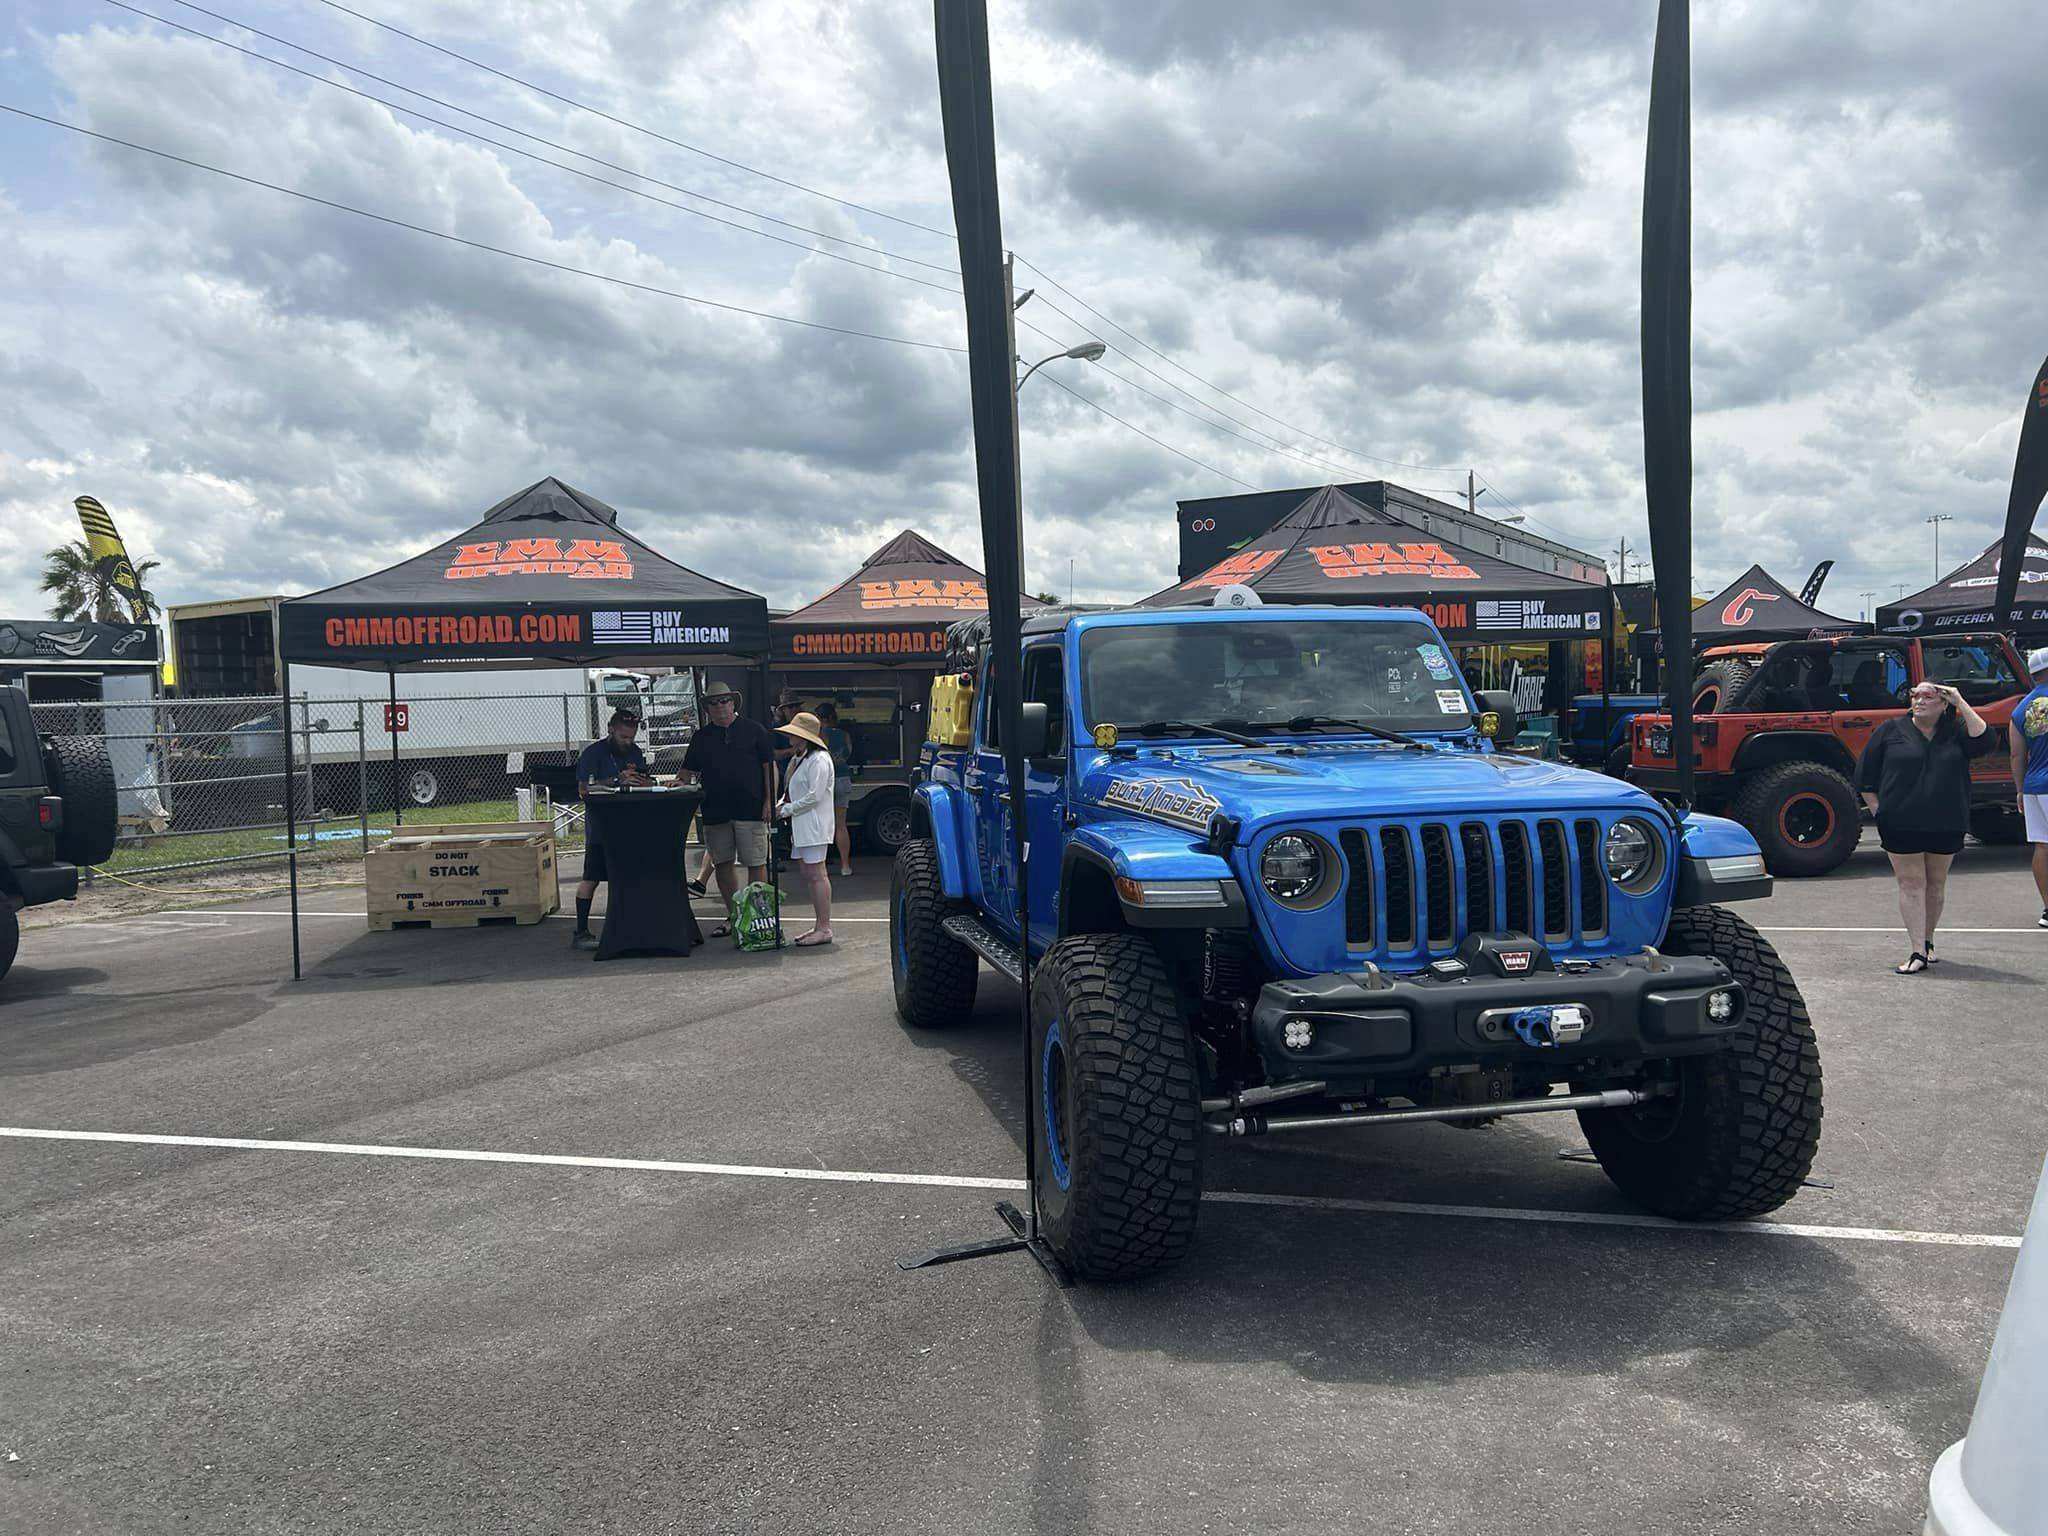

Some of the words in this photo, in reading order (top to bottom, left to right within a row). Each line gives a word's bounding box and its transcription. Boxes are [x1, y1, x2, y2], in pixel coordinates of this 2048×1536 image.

[1522, 601, 1546, 615] BUY
[652, 611, 683, 627] BUY
[1523, 615, 1582, 629] AMERICAN
[325, 613, 581, 647] CMMOFFROAD.COM
[653, 627, 730, 644] AMERICAN
[792, 631, 947, 655] CMMOFFROAD.C
[1510, 660, 1546, 714] CURRIE
[1104, 780, 1218, 821] OUTLANDER
[435, 853, 449, 861] DO
[450, 852, 469, 860] NOT
[429, 866, 480, 878] STACK
